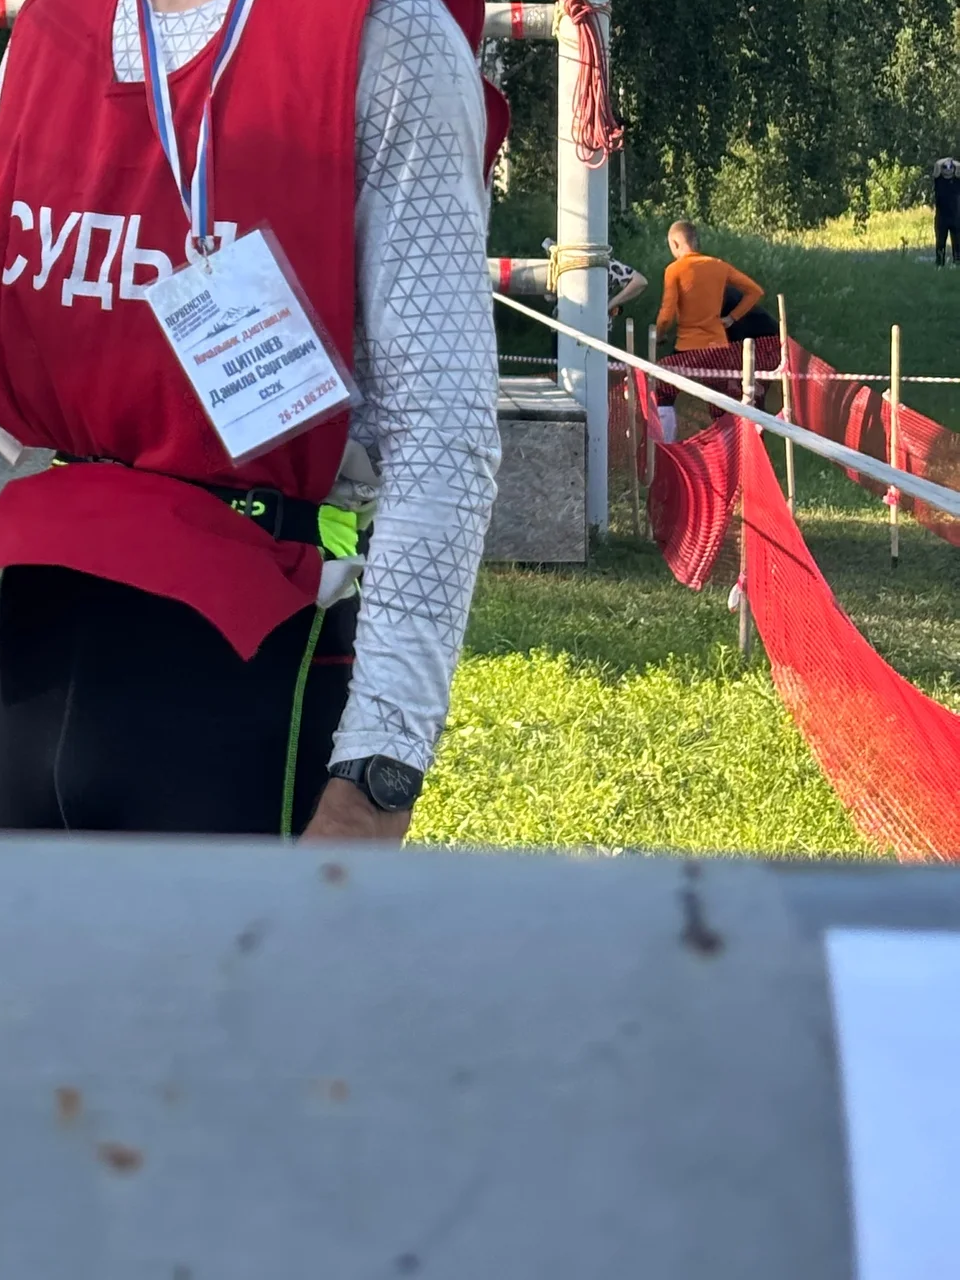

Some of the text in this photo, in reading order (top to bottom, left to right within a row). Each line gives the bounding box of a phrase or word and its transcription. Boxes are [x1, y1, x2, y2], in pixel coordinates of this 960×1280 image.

[164, 289, 212, 329] ПЕРВЕНСТВО
[208, 339, 318, 408] Данила Сергеевич
[222, 335, 284, 377] ЩИПАЧЕВ
